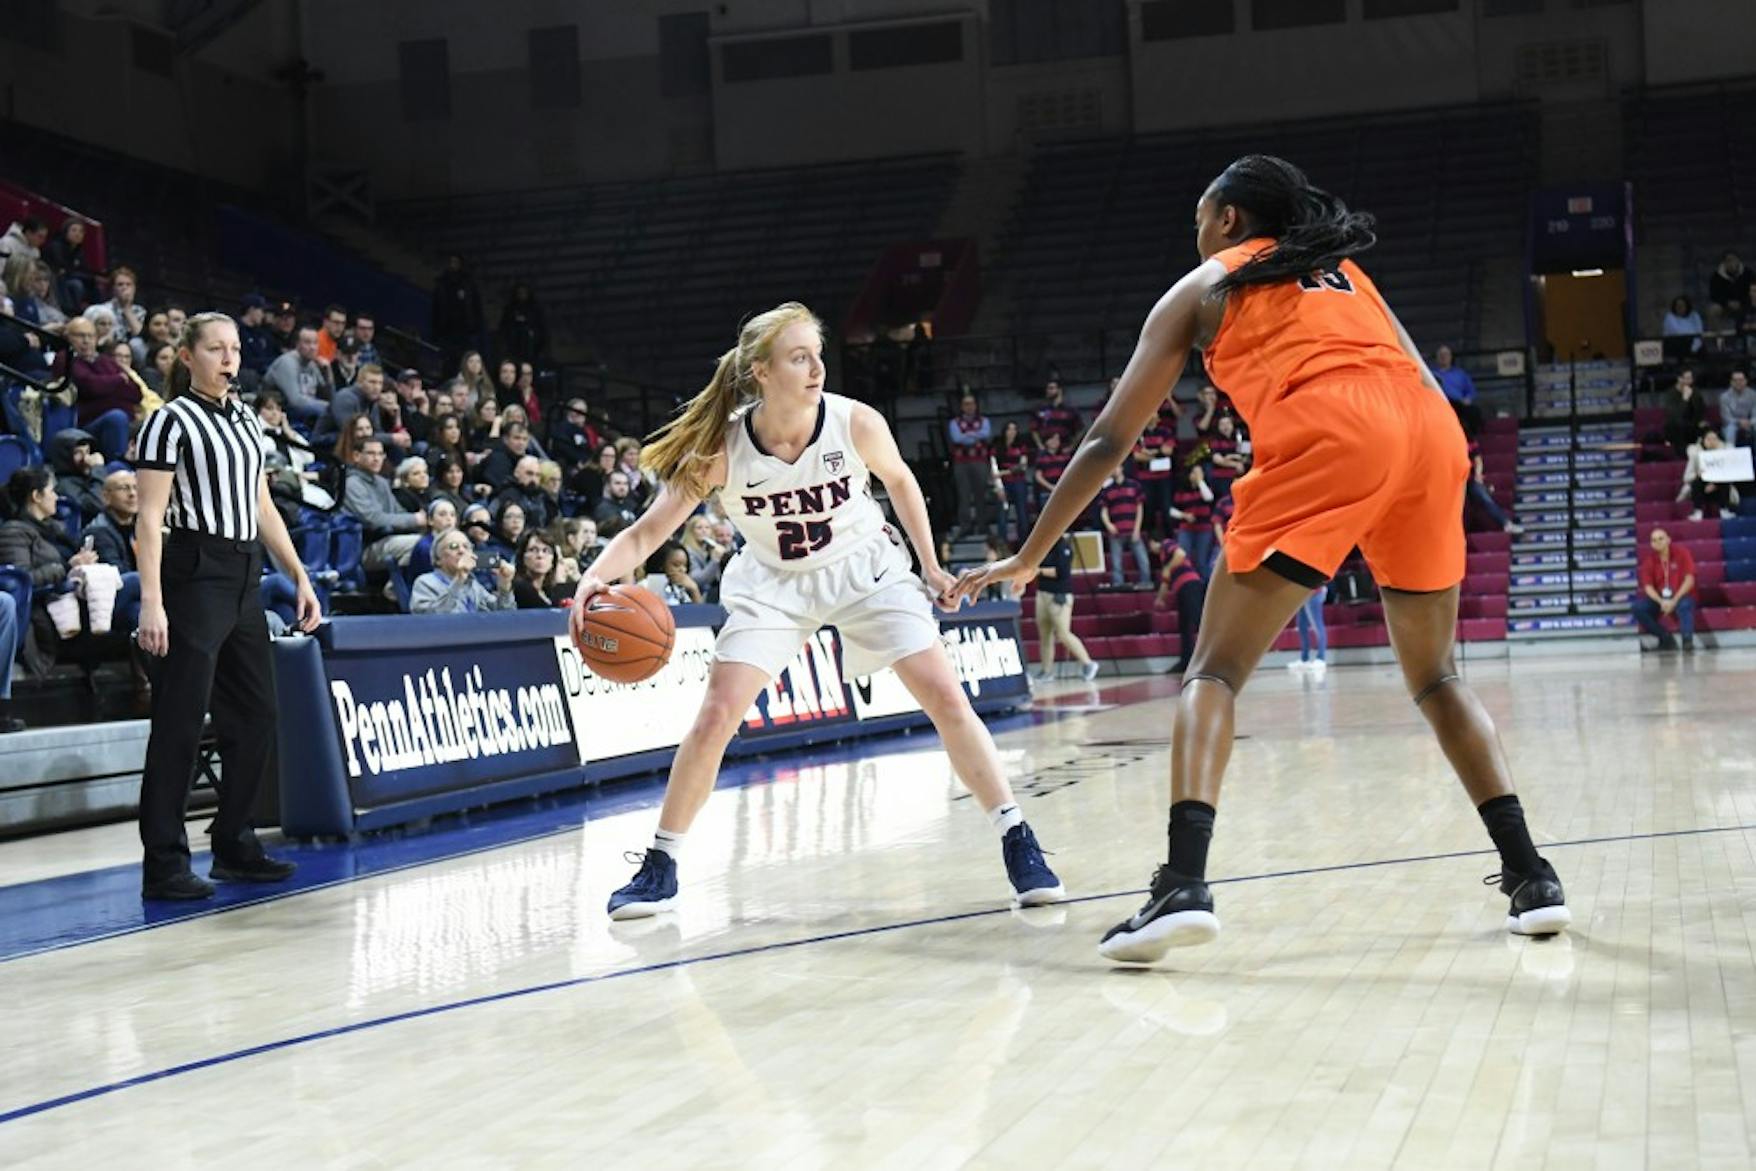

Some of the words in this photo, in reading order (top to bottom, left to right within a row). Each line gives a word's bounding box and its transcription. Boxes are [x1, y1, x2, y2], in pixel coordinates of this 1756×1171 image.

[741, 475, 852, 518] PENN
[775, 517, 834, 561] 25
[330, 664, 572, 778] PennAthletics.com
